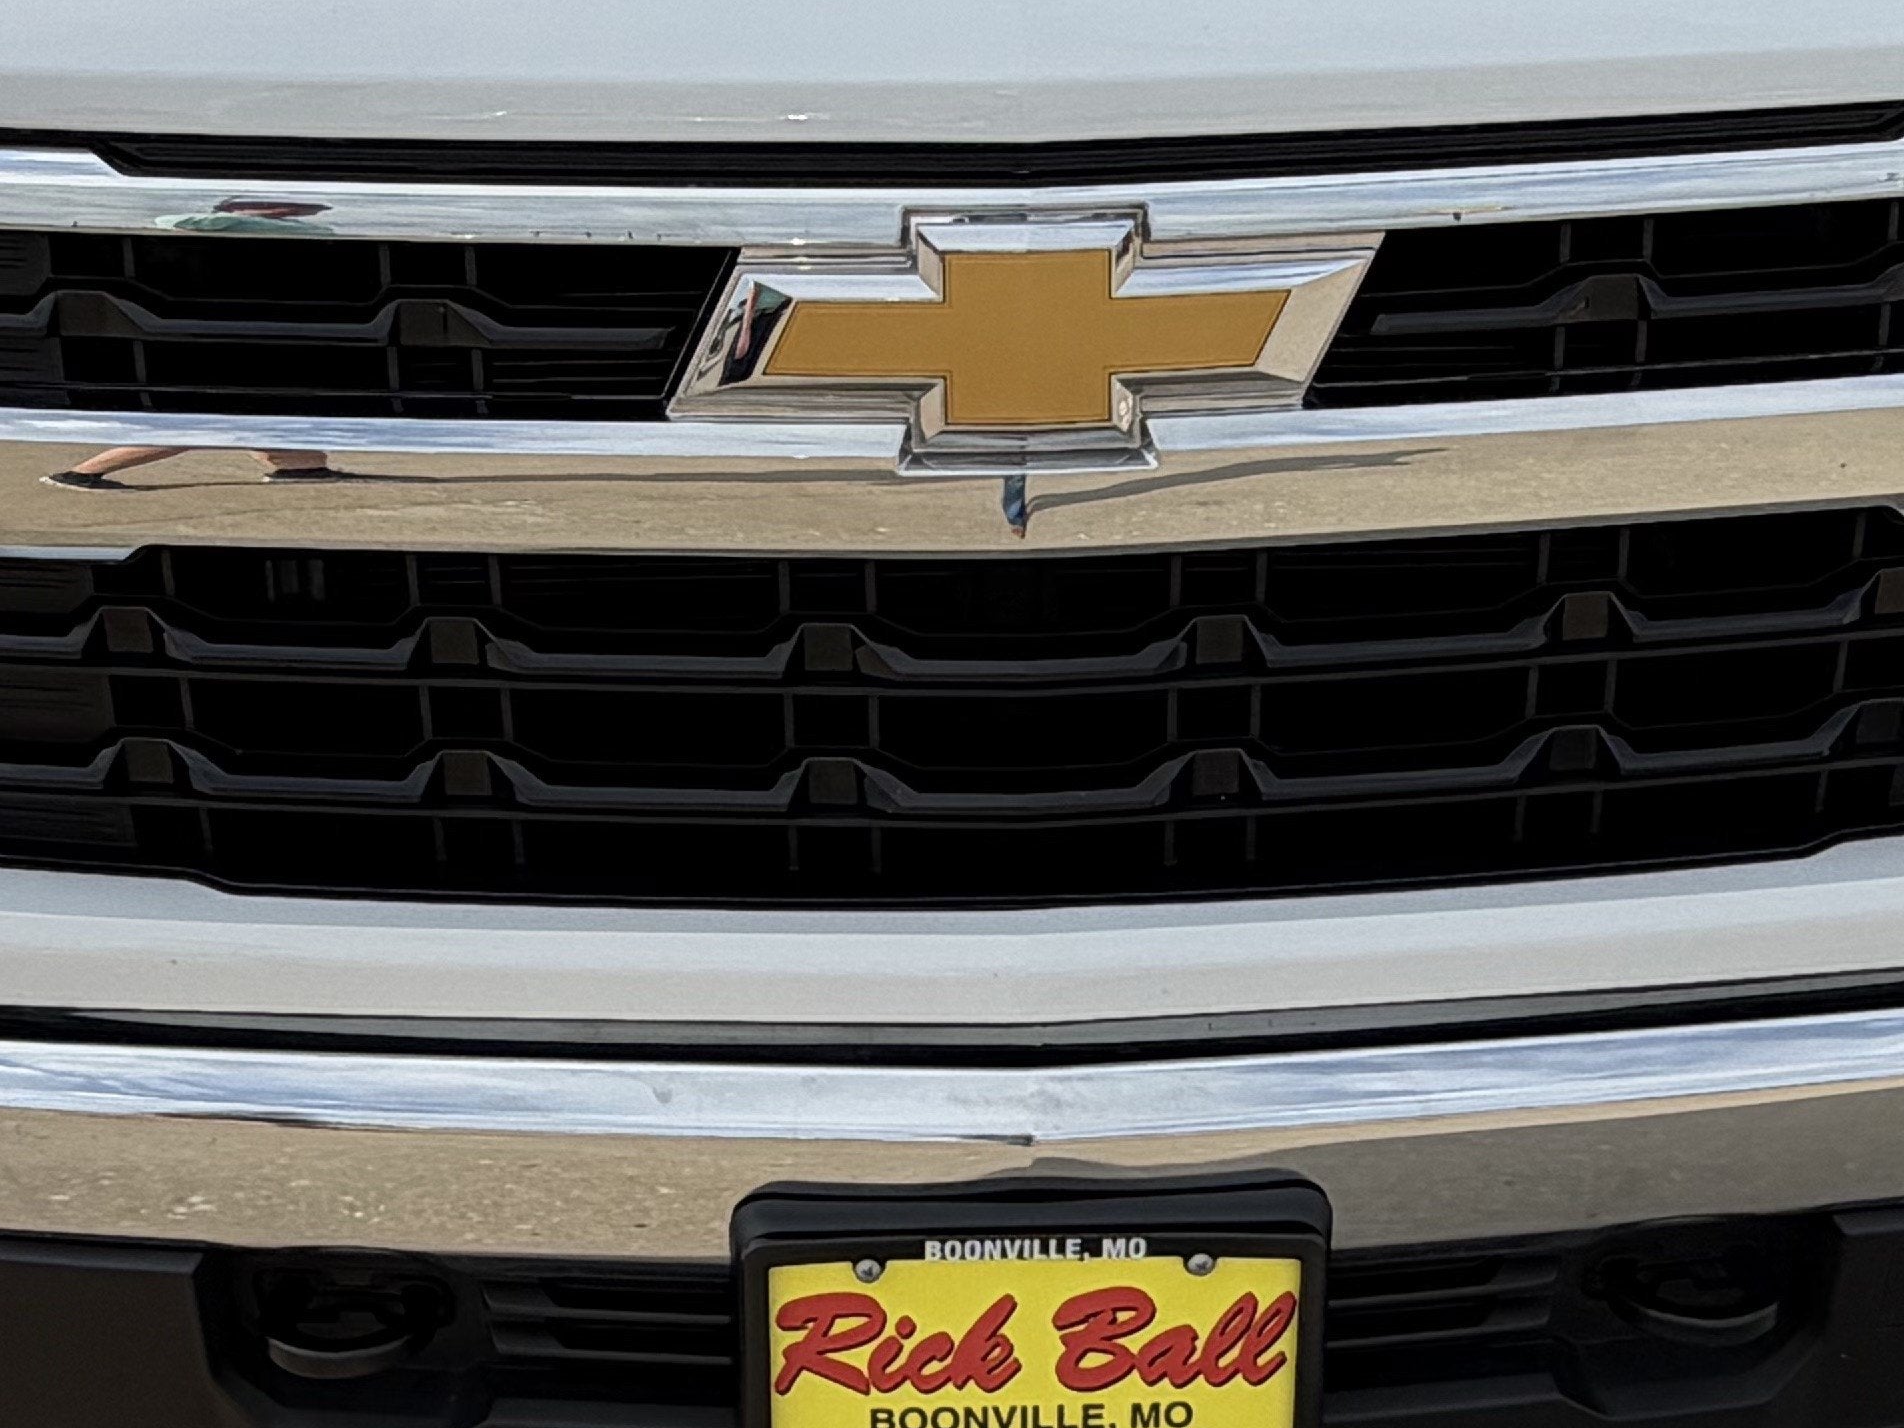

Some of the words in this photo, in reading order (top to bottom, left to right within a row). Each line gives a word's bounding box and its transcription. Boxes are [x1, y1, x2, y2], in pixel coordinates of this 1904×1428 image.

[924, 1238, 1093, 1264] BOONVILLE,
[1102, 1238, 1148, 1261] MO
[775, 1291, 1022, 1396] Rick
[1052, 1285, 1297, 1393] Ball
[1131, 1402, 1194, 1428] MO
